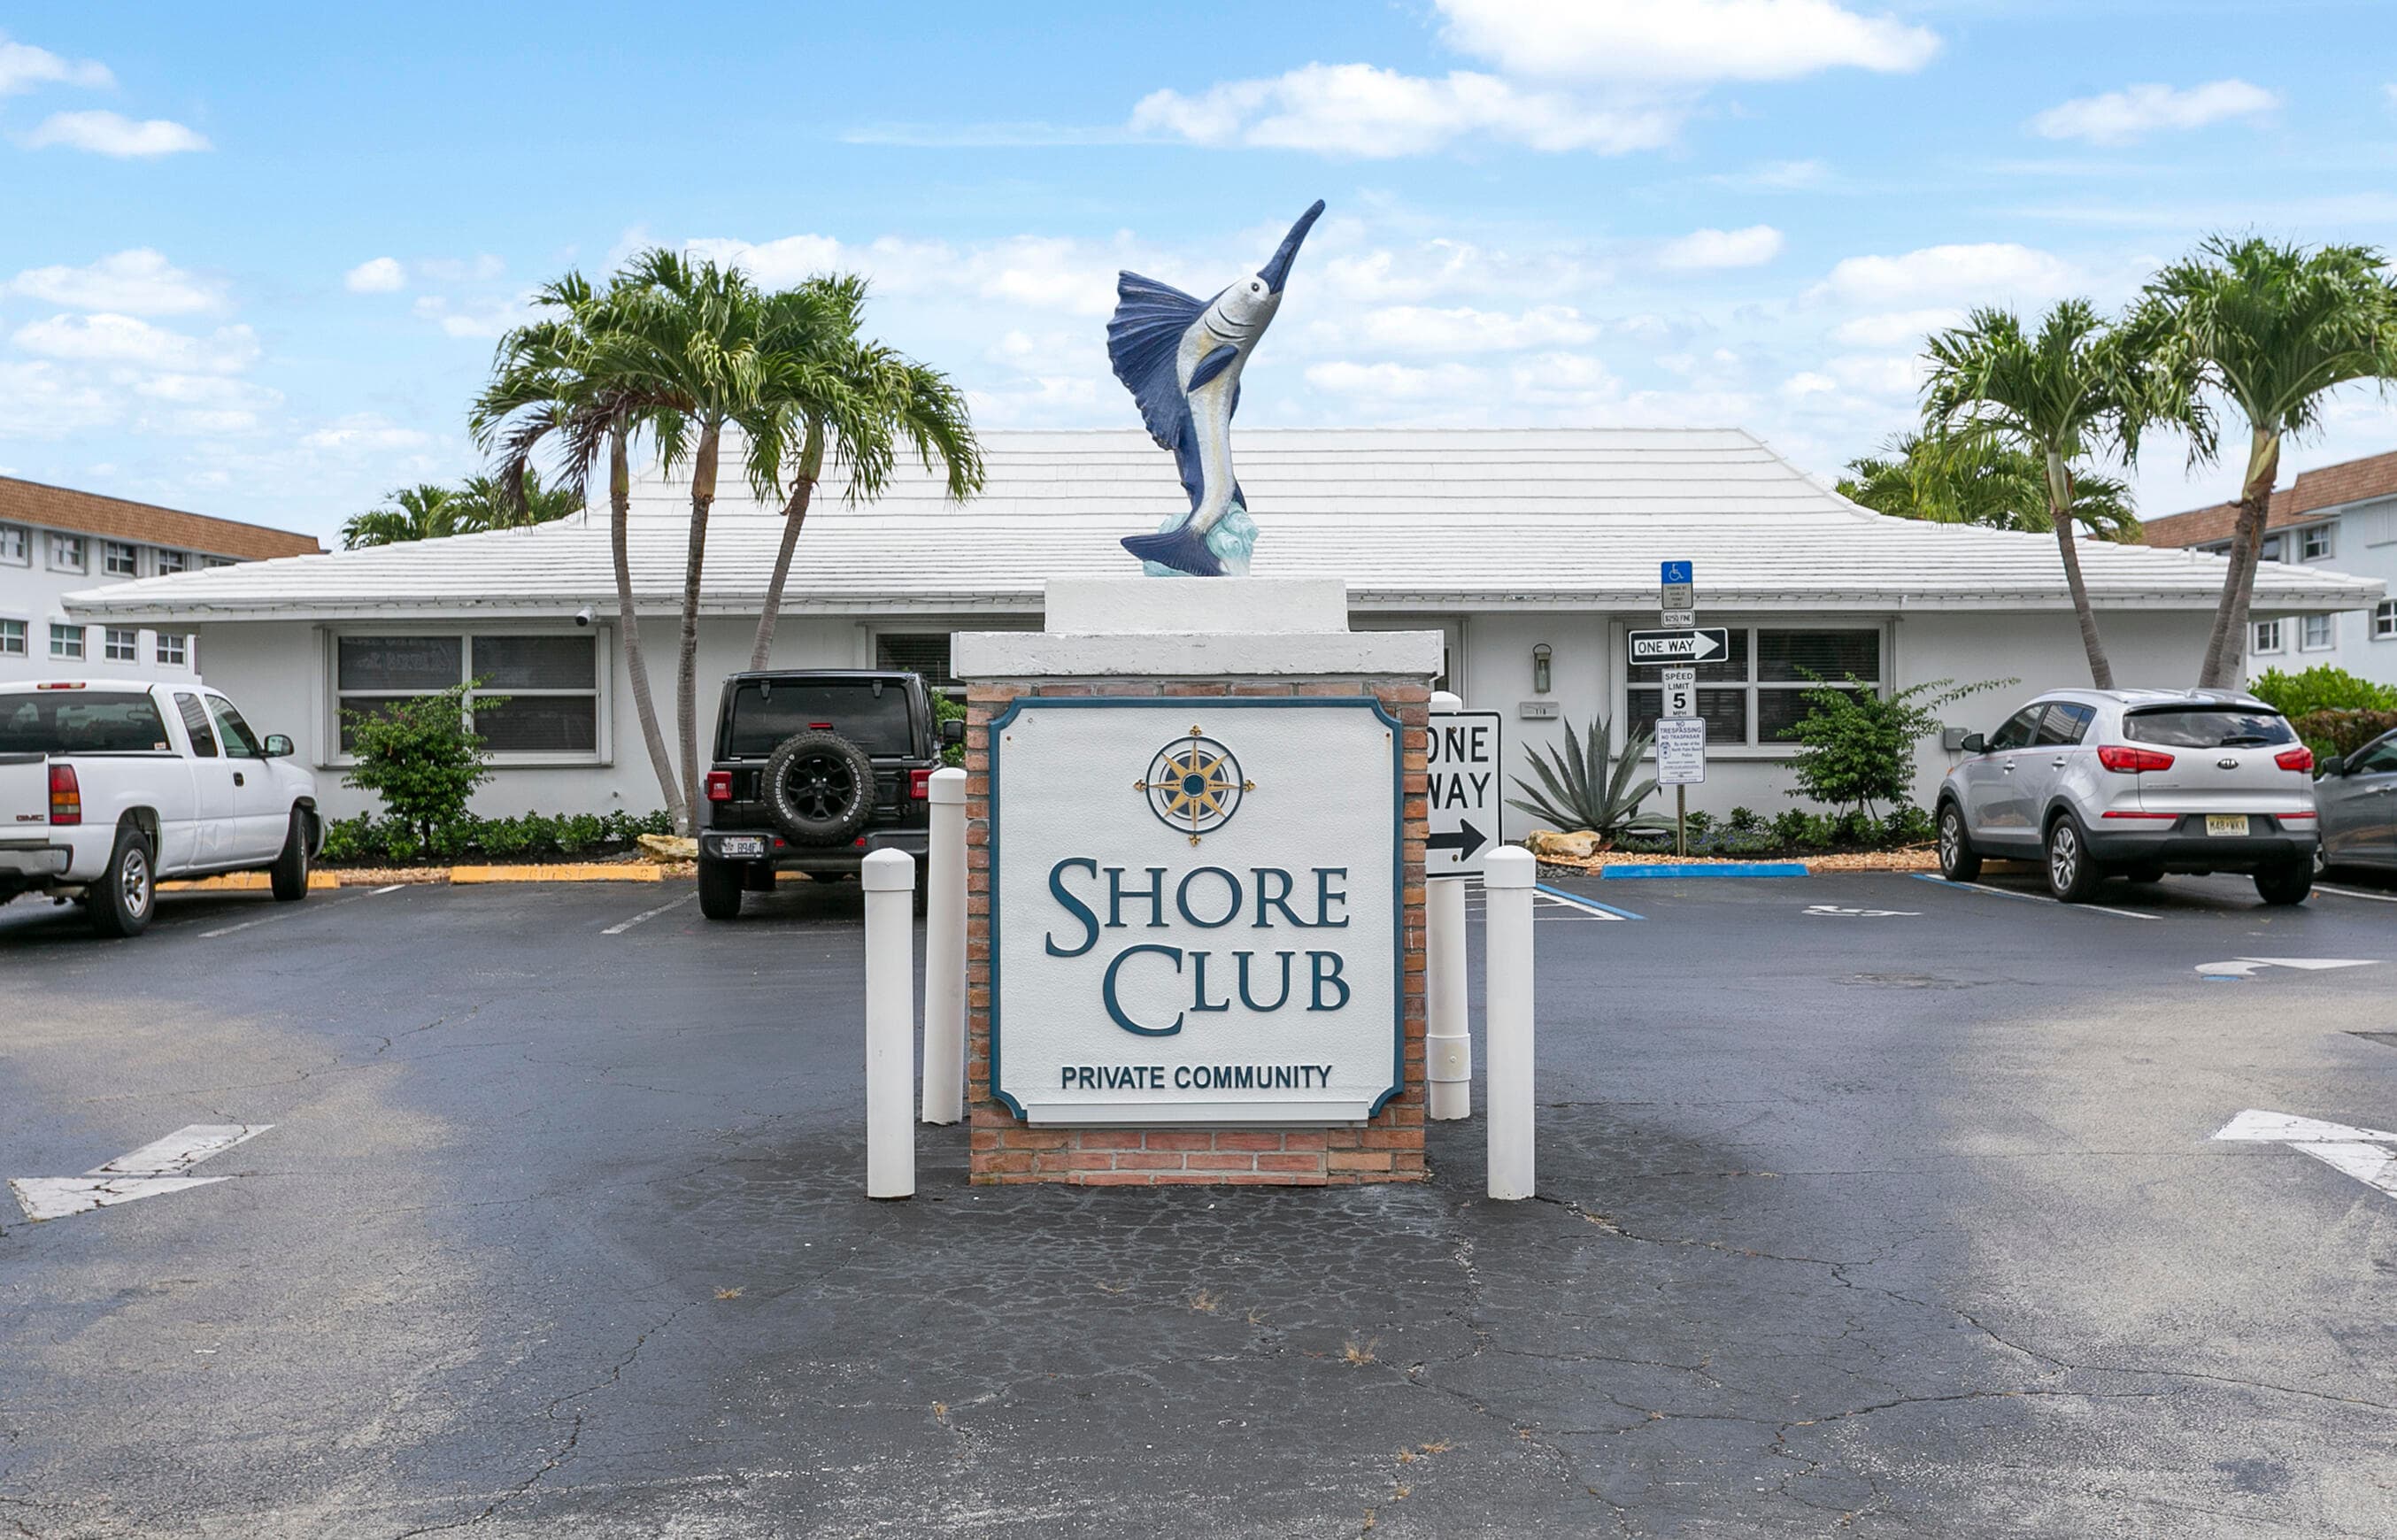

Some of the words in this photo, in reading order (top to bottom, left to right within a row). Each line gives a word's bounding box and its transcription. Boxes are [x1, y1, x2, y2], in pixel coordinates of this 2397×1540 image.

[1638, 640, 1664, 653] ONE
[1668, 639, 1694, 652] WAY
[1673, 692, 1686, 709] 5
[1427, 727, 1489, 763] ONE
[1044, 857, 1350, 958] SHORE
[1102, 943, 1351, 1036] CLUB
[1061, 1066, 1166, 1090] PRIVATE
[1174, 1065, 1333, 1090] COMMUNITY
